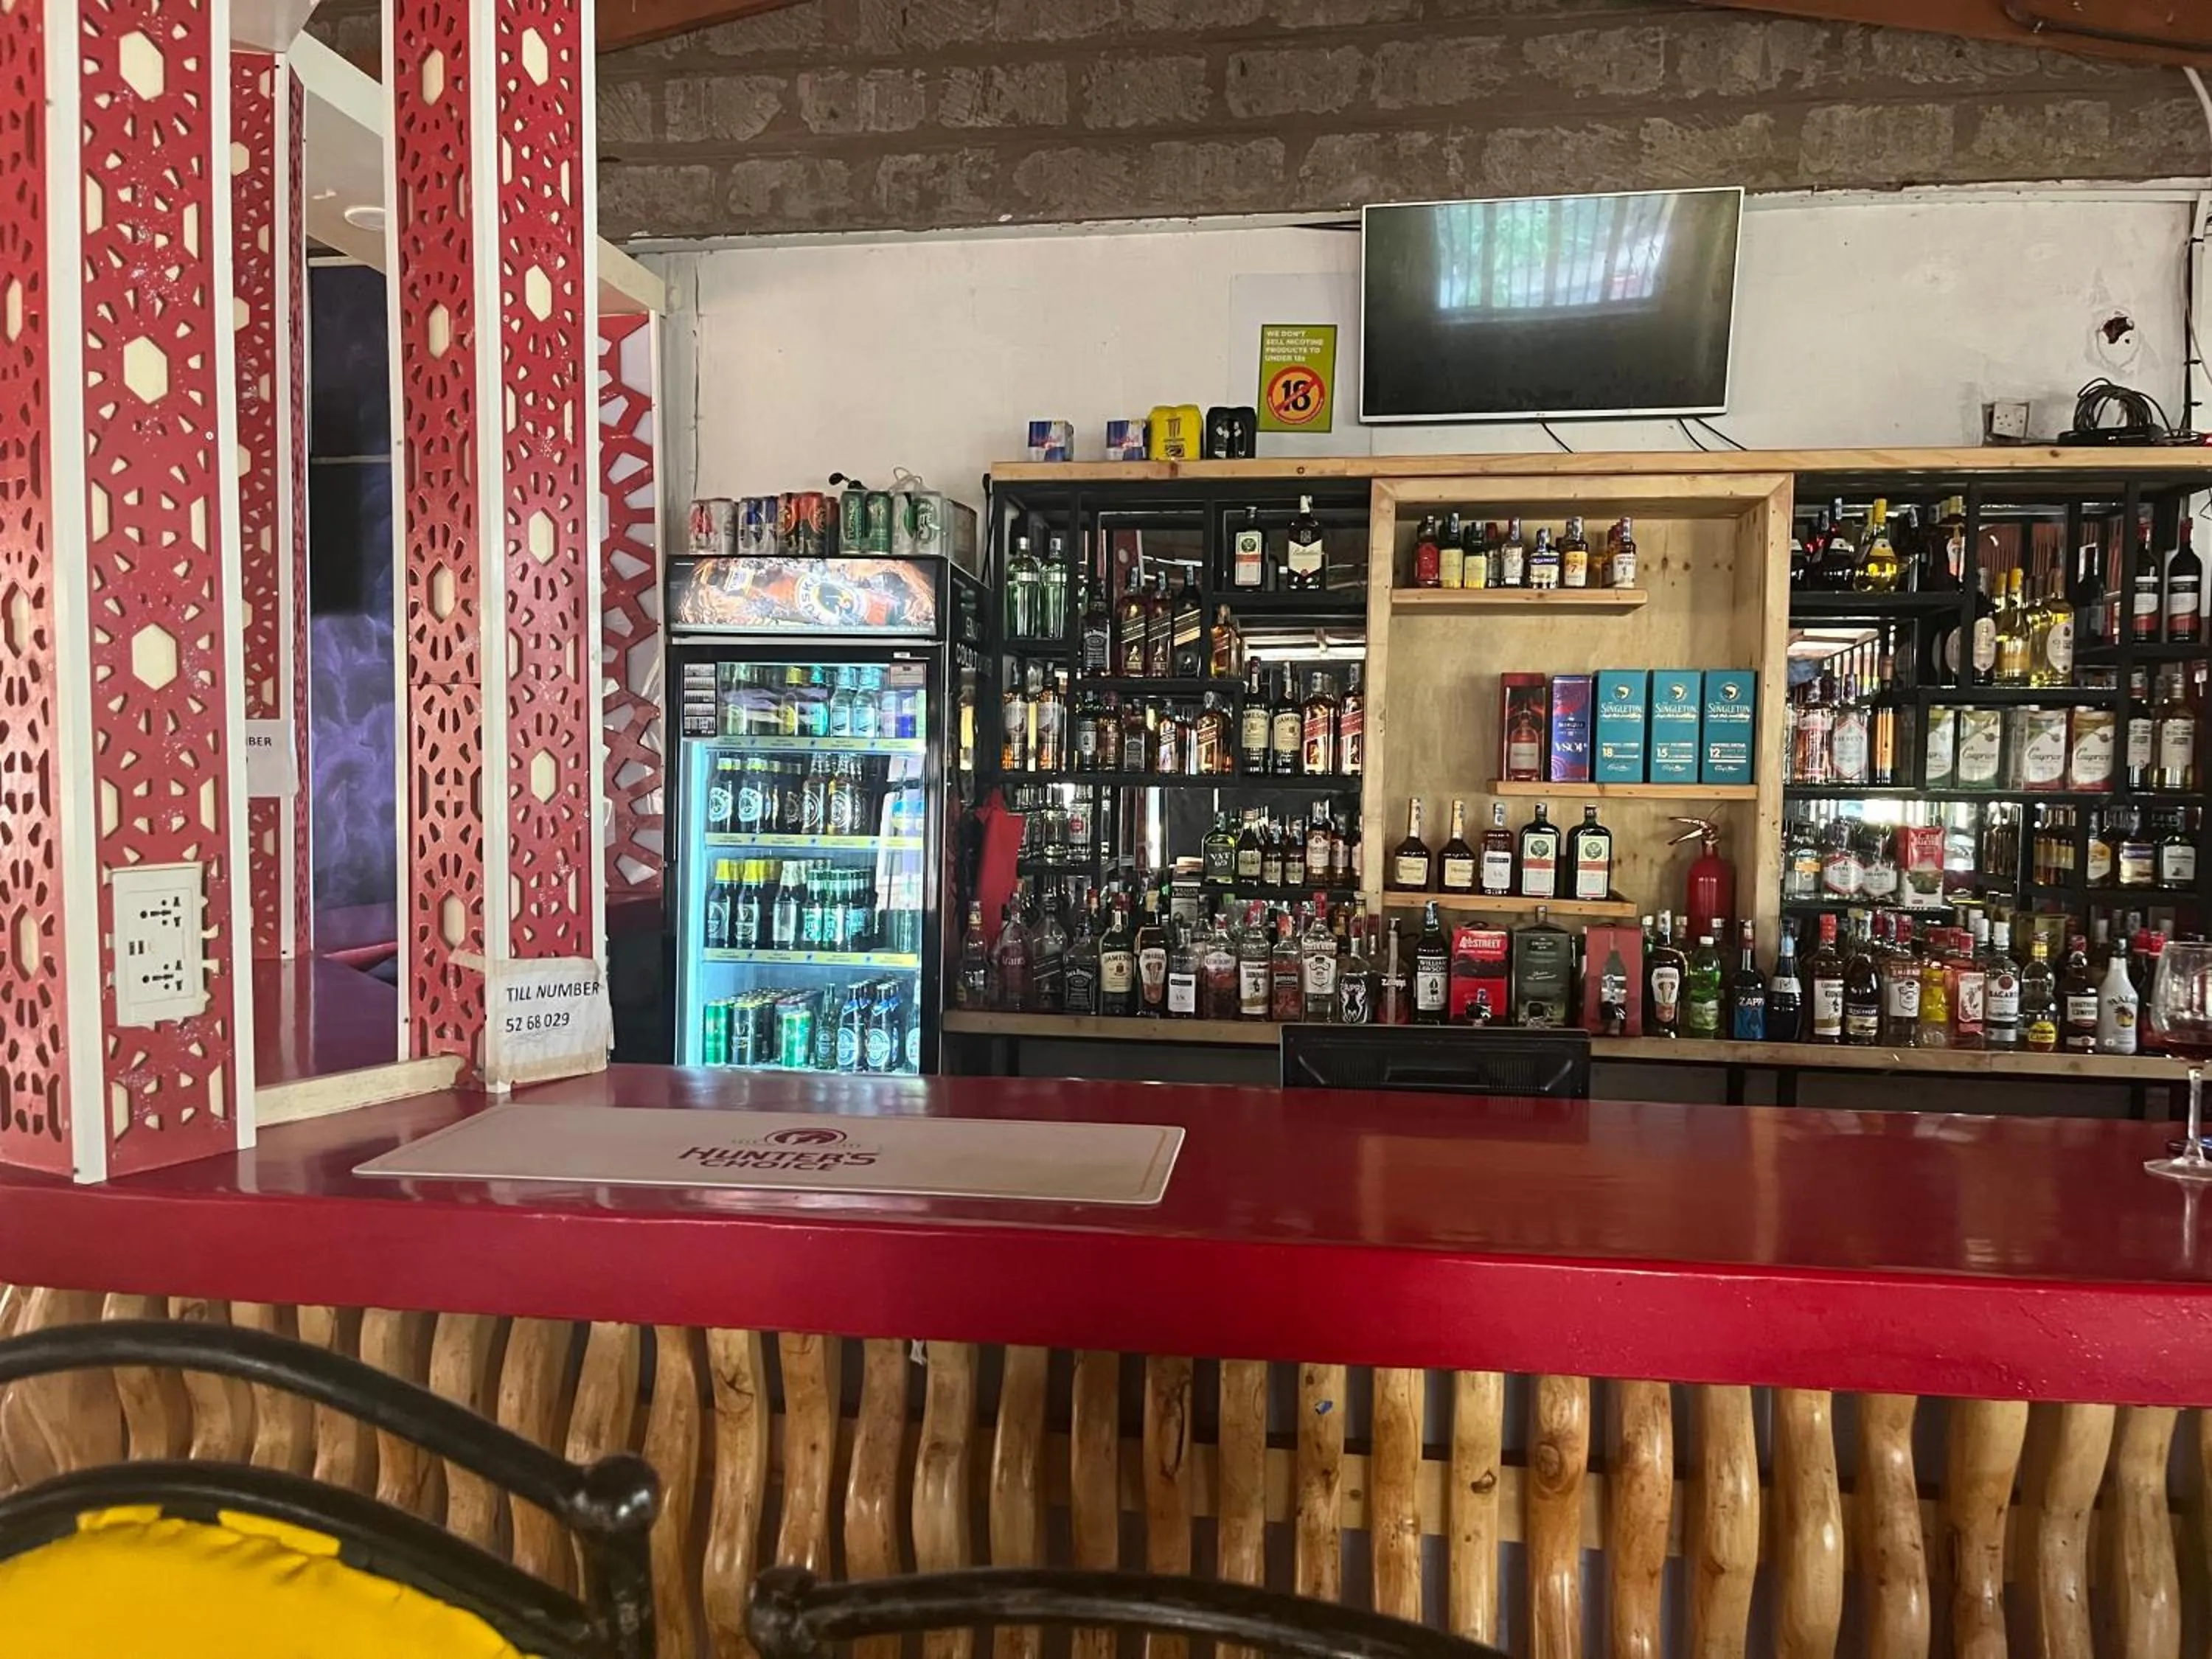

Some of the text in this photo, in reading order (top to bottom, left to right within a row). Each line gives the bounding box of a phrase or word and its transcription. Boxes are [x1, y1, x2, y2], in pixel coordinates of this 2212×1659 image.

[1281, 380, 1311, 411] 18
[246, 737, 272, 746] BER
[507, 981, 600, 1002] TILL NUMBER
[506, 1012, 570, 1033] 52 68 029
[678, 1146, 882, 1166] HUNTER'S
[700, 1159, 835, 1171] CHOICE
